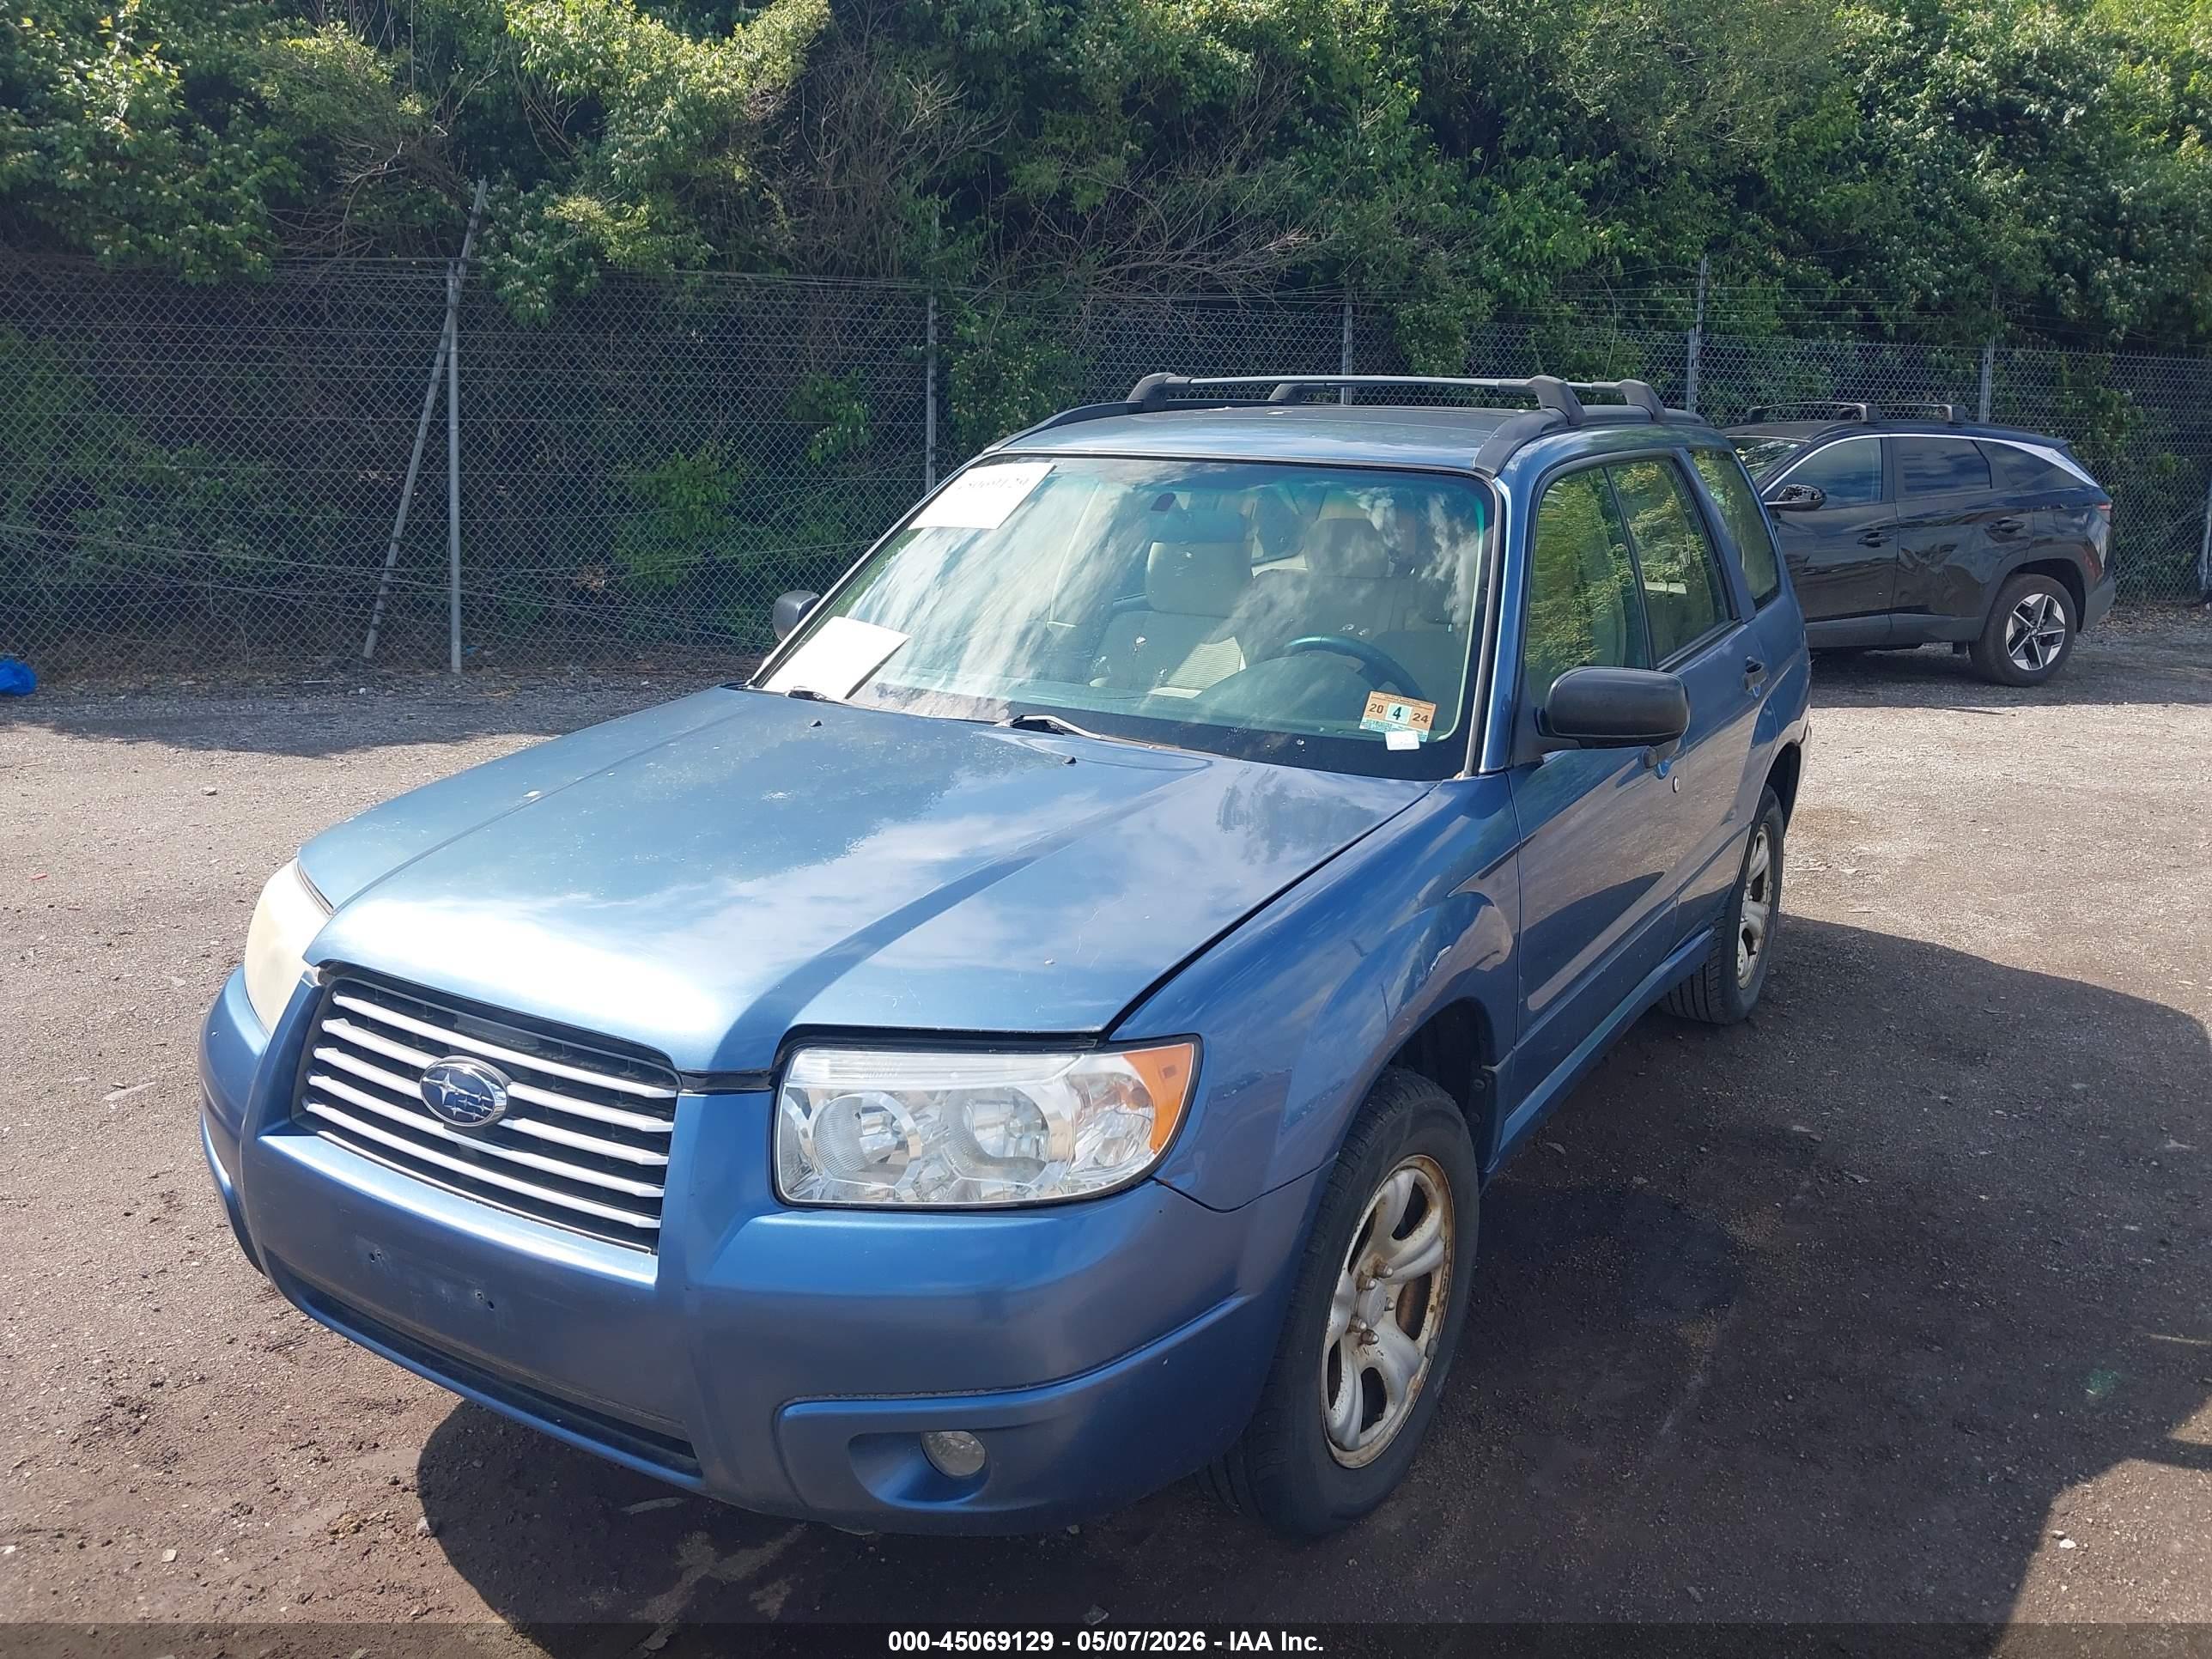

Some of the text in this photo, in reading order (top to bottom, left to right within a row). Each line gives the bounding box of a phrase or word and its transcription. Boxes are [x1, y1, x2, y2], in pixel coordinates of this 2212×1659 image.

[1369, 703, 1429, 724] 20 4 24
